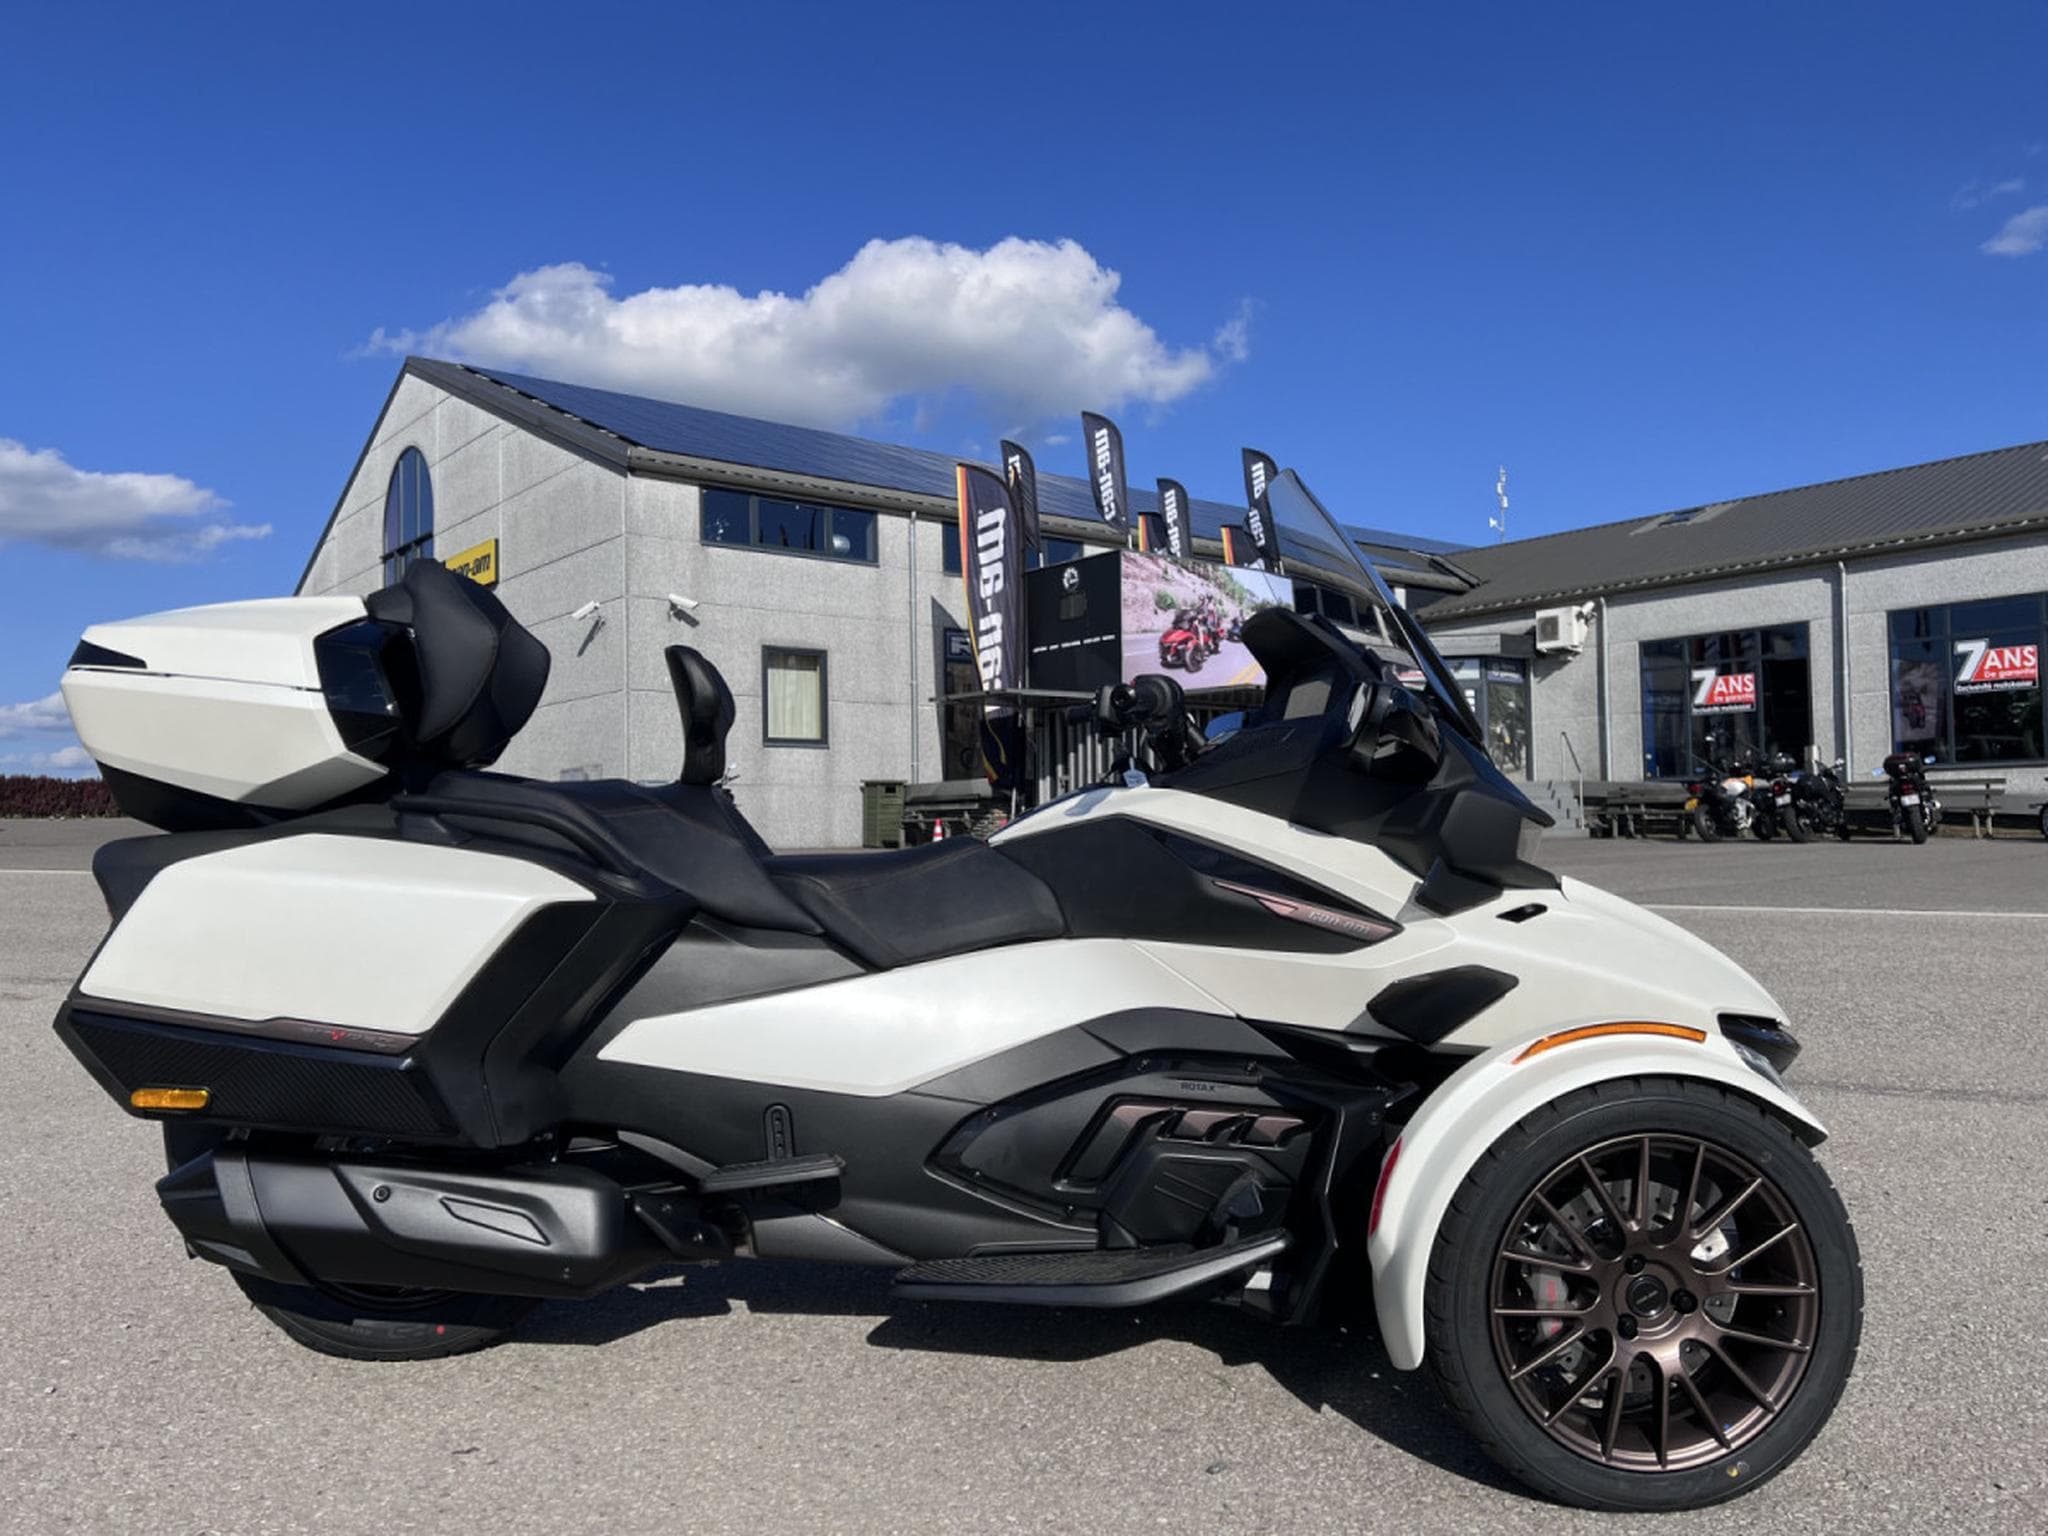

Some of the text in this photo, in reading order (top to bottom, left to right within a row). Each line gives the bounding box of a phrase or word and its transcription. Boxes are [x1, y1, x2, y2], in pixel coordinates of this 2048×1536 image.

[1095, 427, 1117, 522] can-am
[1164, 488, 1182, 557] an-am
[1691, 668, 1755, 704] 7 ANS
[1956, 640, 2036, 682] 7 ANS
